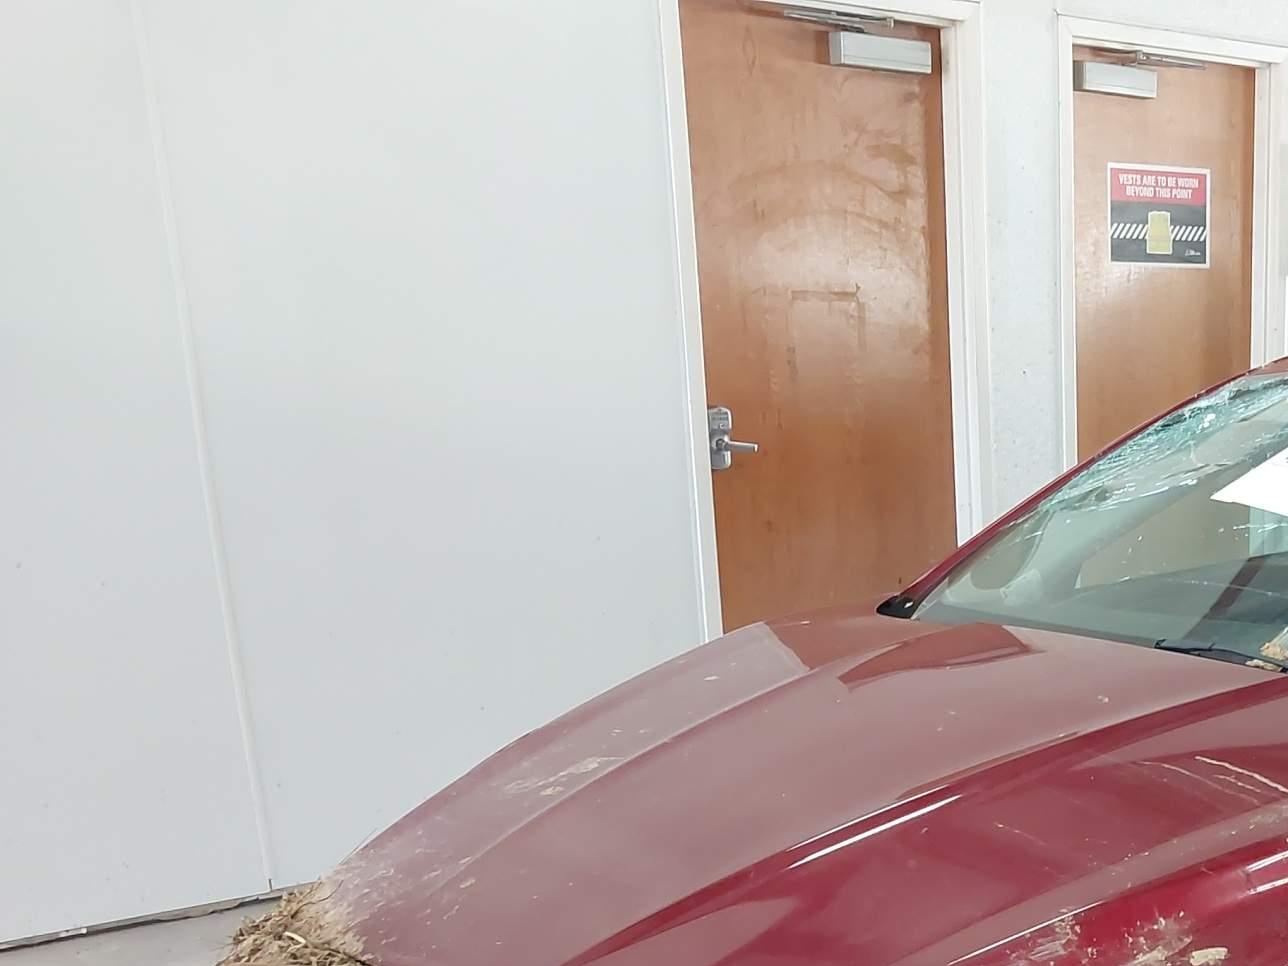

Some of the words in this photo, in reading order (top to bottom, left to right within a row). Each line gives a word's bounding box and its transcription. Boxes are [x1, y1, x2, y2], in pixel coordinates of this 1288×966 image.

[1118, 173, 1141, 185] VESTS
[1142, 175, 1156, 186] ARE
[1157, 176, 1167, 186] TO
[1168, 176, 1177, 187] BE
[1177, 177, 1199, 188] WORN
[1126, 185, 1154, 197] BEYOND
[1155, 187, 1171, 198] THIS
[1172, 188, 1193, 199] POINT
